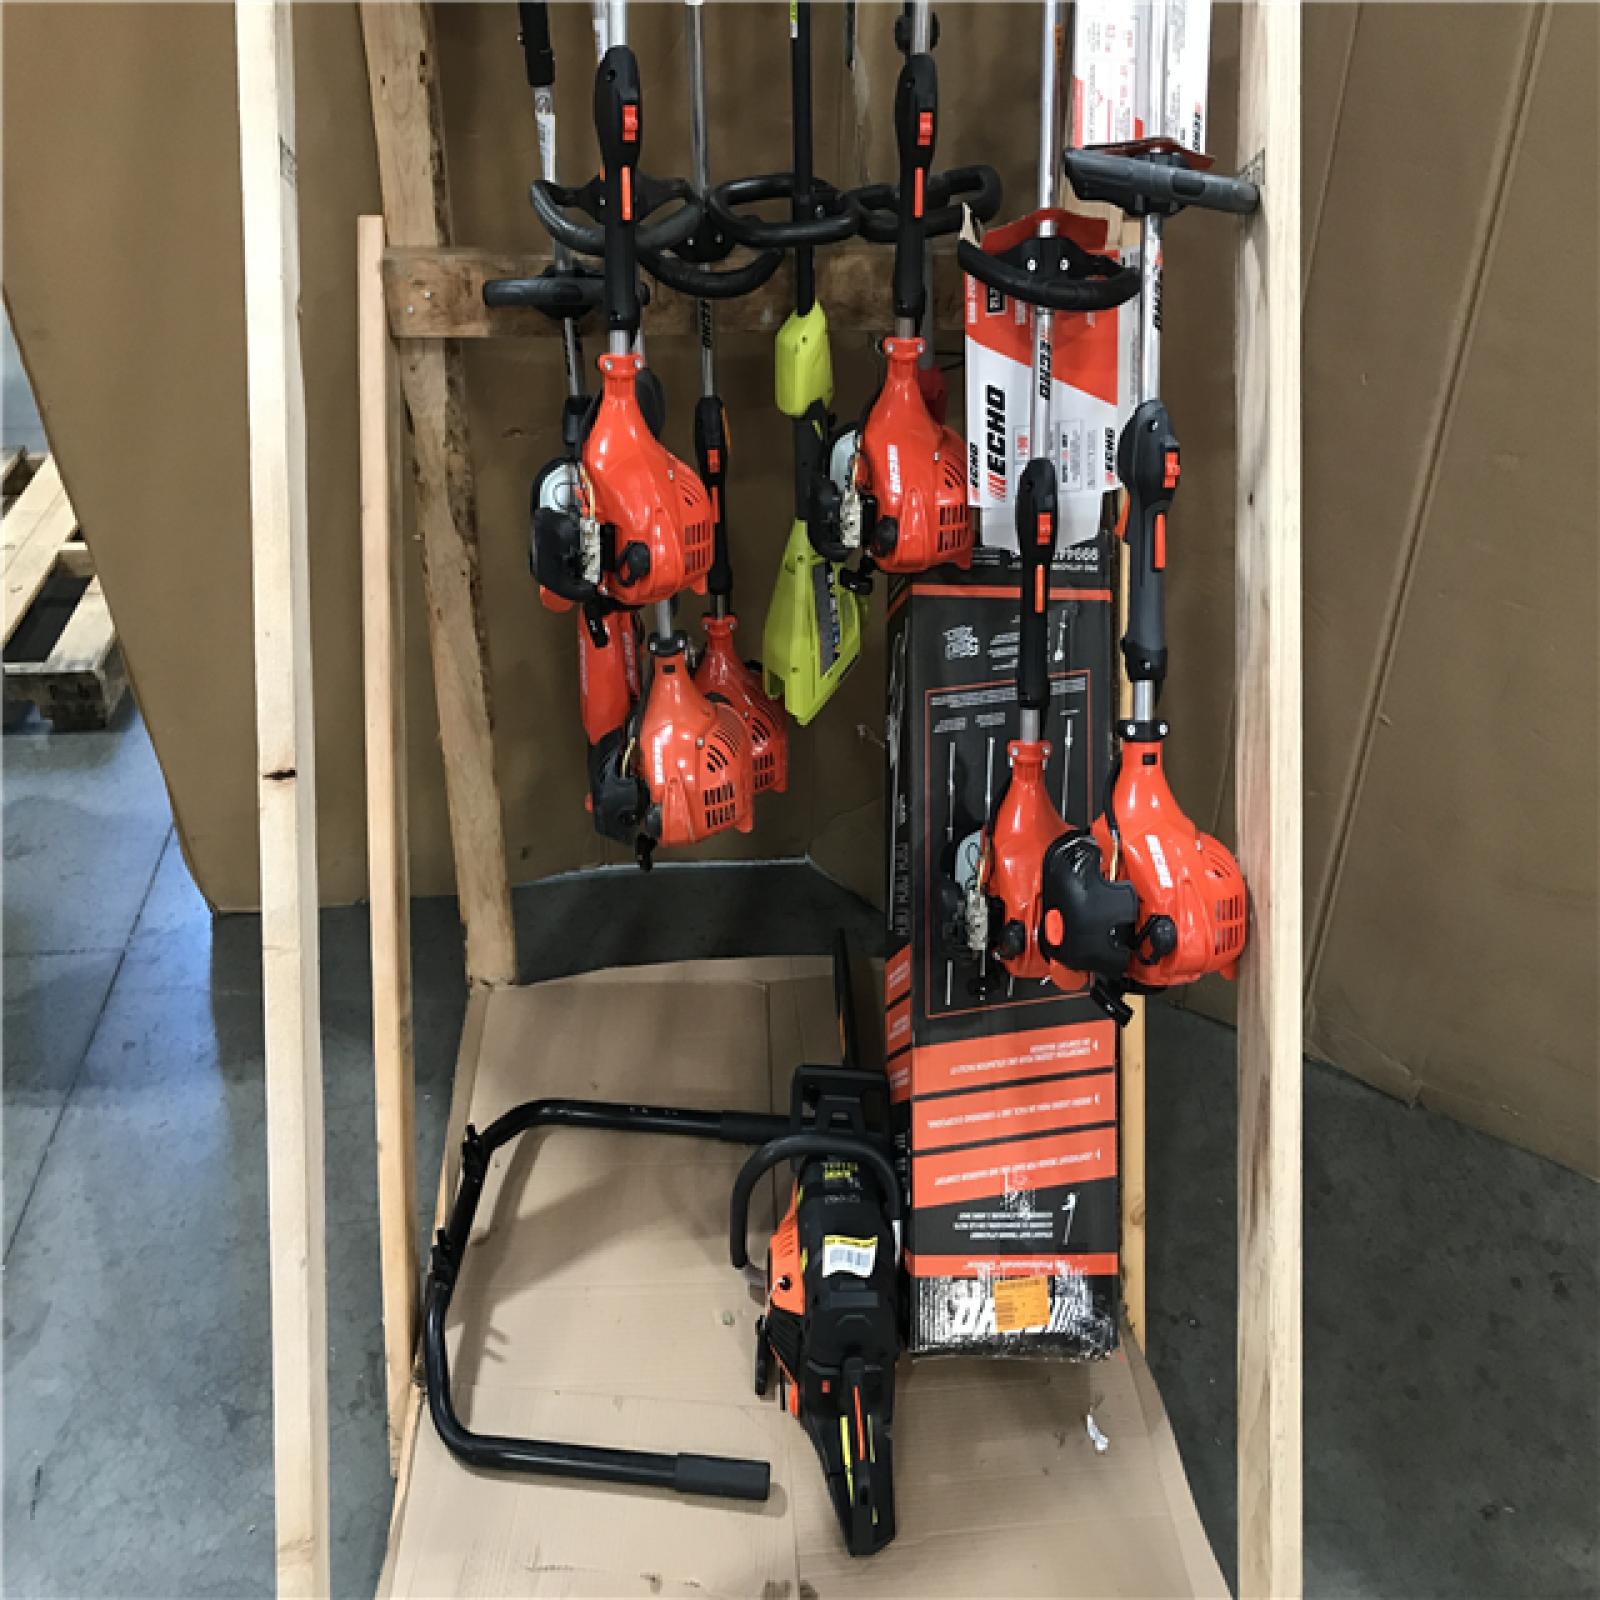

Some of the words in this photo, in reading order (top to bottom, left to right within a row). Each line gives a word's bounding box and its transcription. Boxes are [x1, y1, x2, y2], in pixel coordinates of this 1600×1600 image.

[1039, 338, 1051, 401] ECHO
[985, 384, 1007, 476] ECHO
[1104, 426, 1116, 478] ECHO
[968, 441, 979, 488] ECHO
